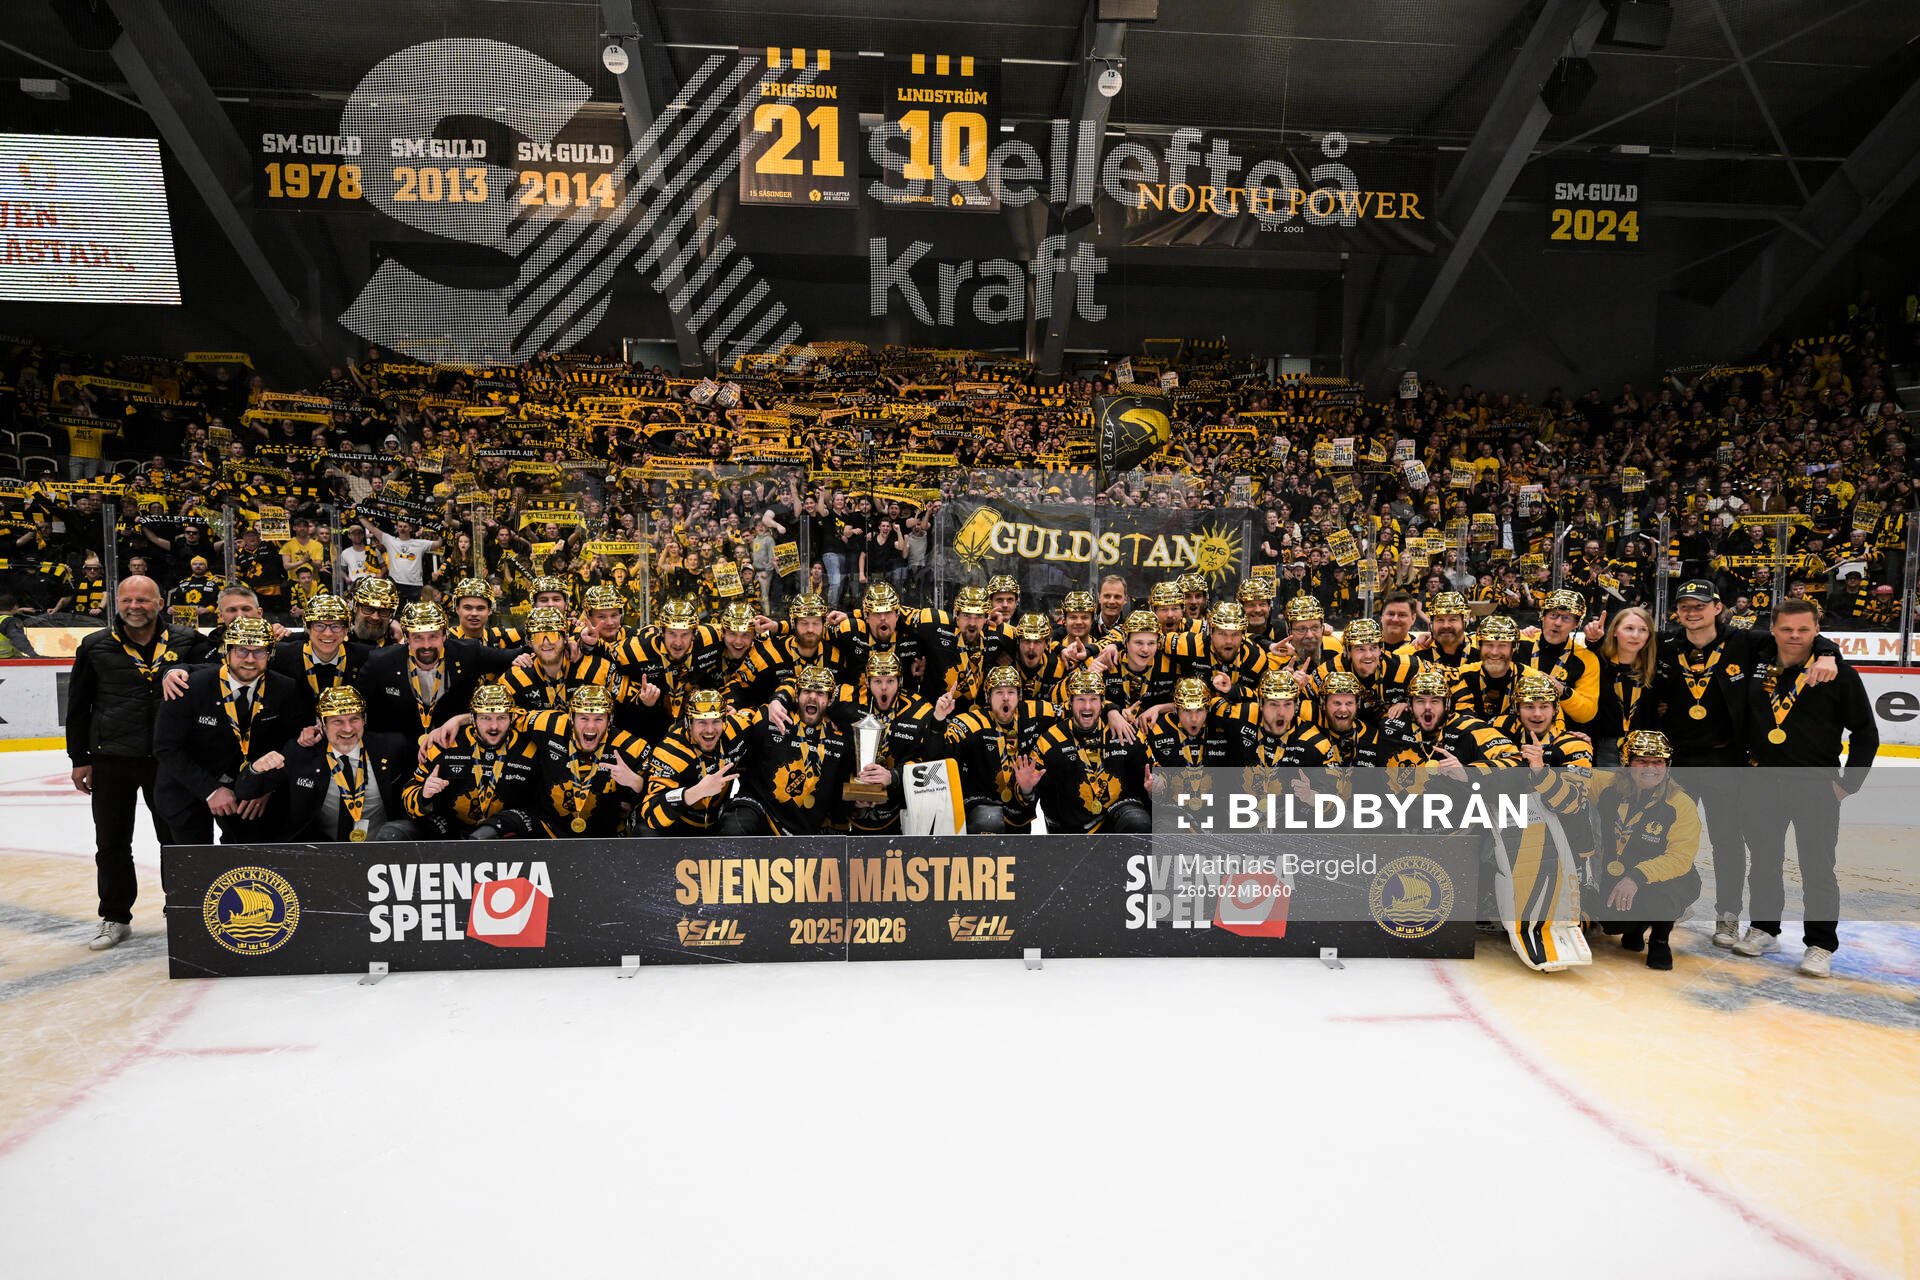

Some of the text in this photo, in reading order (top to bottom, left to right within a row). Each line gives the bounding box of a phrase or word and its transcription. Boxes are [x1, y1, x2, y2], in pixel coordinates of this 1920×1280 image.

[761, 82, 838, 100] ERICSSON
[897, 87, 988, 105] LINDSTRÖM
[262, 132, 363, 156] SM-GULD
[391, 137, 488, 159] SM-GULD
[517, 141, 615, 164] SM-GULD
[753, 103, 845, 178] 21
[898, 109, 988, 182] 10
[264, 162, 363, 200] 1978
[392, 166, 489, 203] 2013
[518, 170, 616, 208] 2014
[867, 119, 1359, 228] Skellefteå
[1554, 182, 1639, 202] SM-GULD
[1136, 182, 1425, 220] NORTH POWER
[1260, 222, 1305, 234] EST. 2001
[1550, 208, 1640, 242] 2024
[869, 234, 1109, 327] Kraft
[366, 861, 554, 902] SVENSKA
[674, 849, 1017, 906] SVENSKA MÄSTARE
[368, 903, 466, 943] SPEL
[684, 919, 747, 940] SHL
[956, 915, 1015, 936] SHL
[1125, 893, 1213, 930] SPEL
[789, 917, 907, 944] 2025/2026
